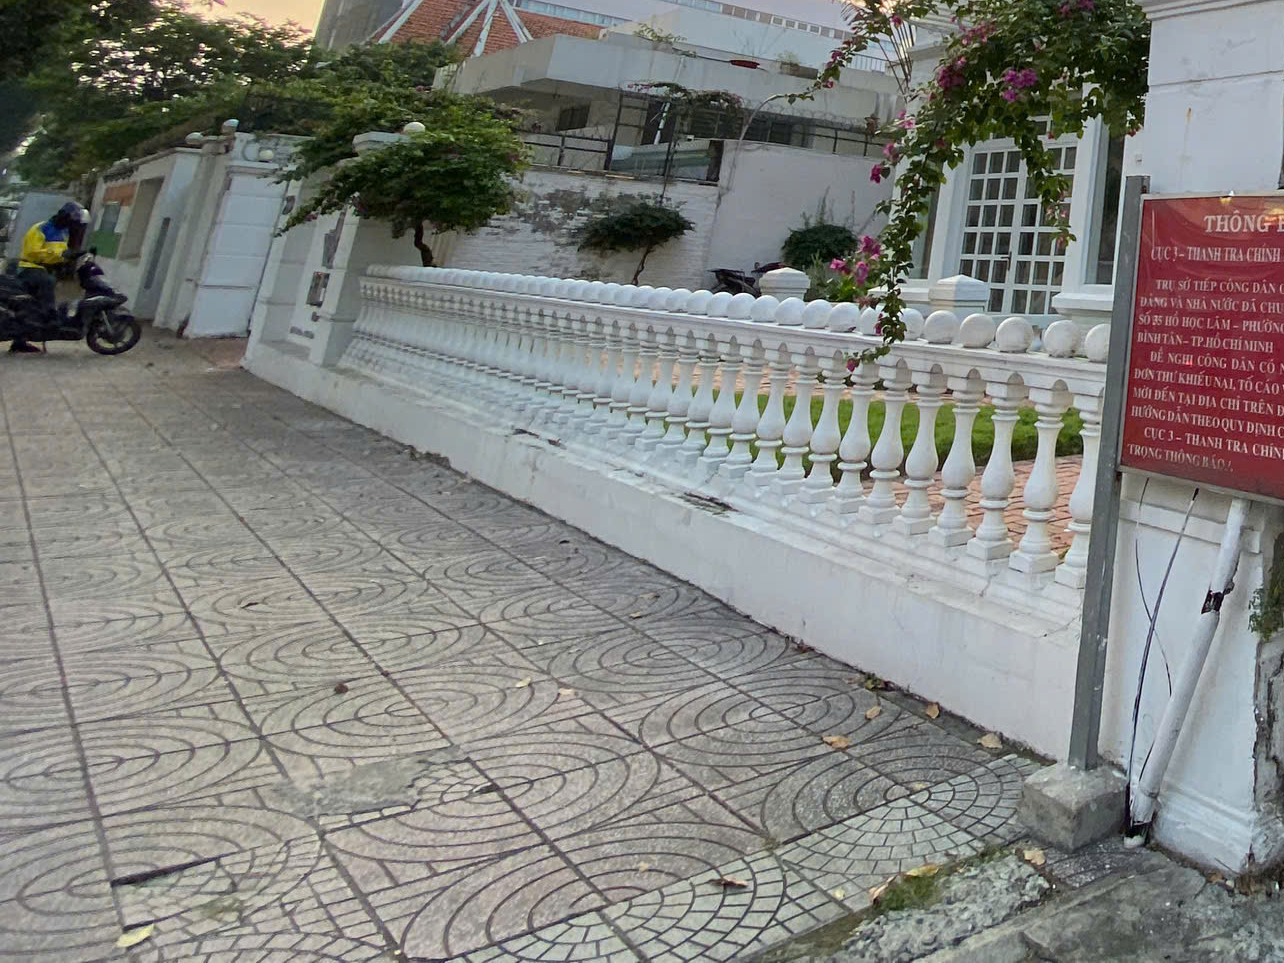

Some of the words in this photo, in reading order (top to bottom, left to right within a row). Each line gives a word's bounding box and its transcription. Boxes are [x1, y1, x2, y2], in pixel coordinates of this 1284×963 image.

[1203, 210, 1268, 233] THÔNG
[1187, 246, 1221, 262] THANH
[1224, 247, 1243, 262] TRA
[1246, 243, 1281, 263] CHÍNH
[1219, 278, 1249, 293] CÔNG
[1252, 279, 1276, 294] DÂN
[1244, 340, 1273, 353] MINH
[1197, 353, 1227, 369] CÔNG
[1259, 359, 1275, 374] CÓ
[1255, 378, 1280, 395] CÁO
[1243, 398, 1274, 415] TRÊN
[1190, 413, 1220, 428] THEO
[1221, 418, 1244, 433] QUY
[1184, 432, 1223, 450] THANH
[1226, 439, 1248, 454] TRA
[1163, 448, 1200, 467] THÔNG
